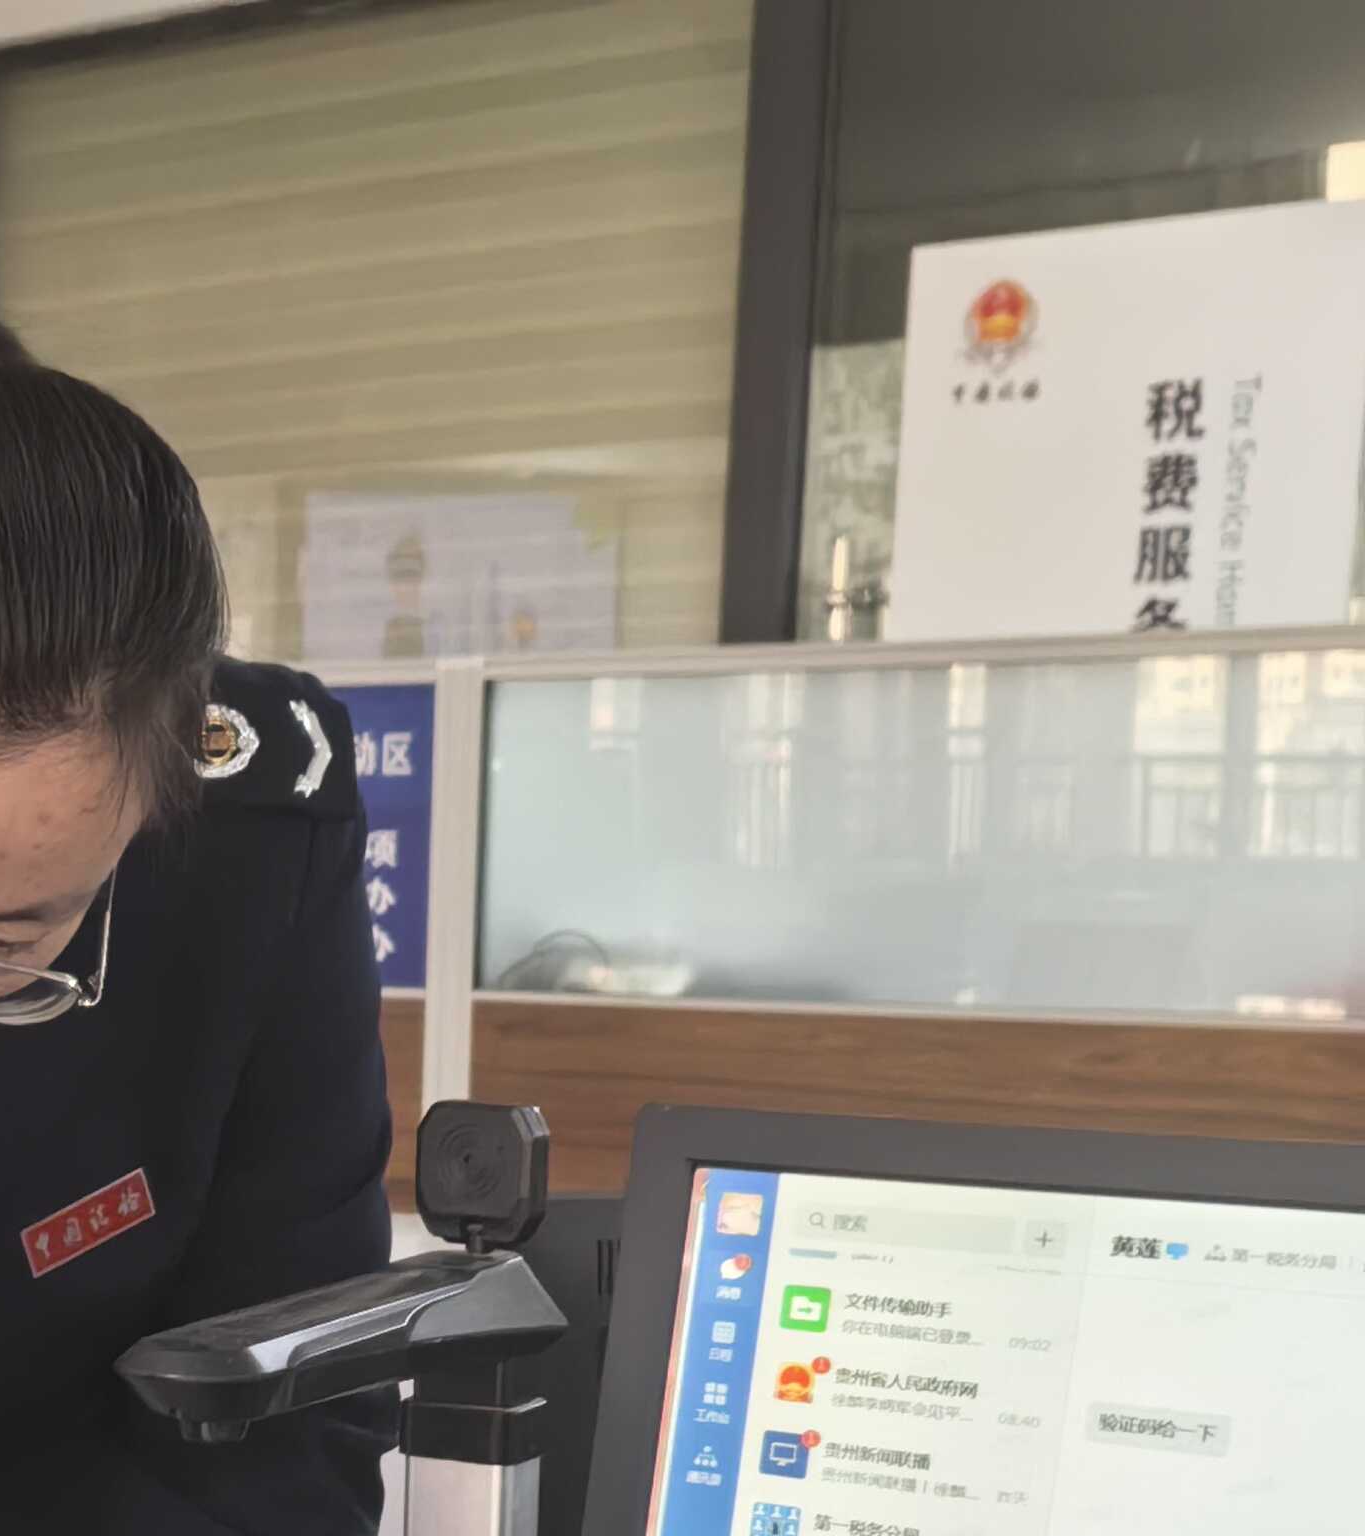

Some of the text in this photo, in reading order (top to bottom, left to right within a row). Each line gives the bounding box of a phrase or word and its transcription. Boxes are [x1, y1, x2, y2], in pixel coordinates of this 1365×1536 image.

[845, 1292, 953, 1318] 文件传输助手
[835, 1367, 979, 1399] 贵州省人民政府网
[1098, 1413, 1219, 1443] 验证码给一下
[824, 1441, 931, 1471] 贵州新闻联播
